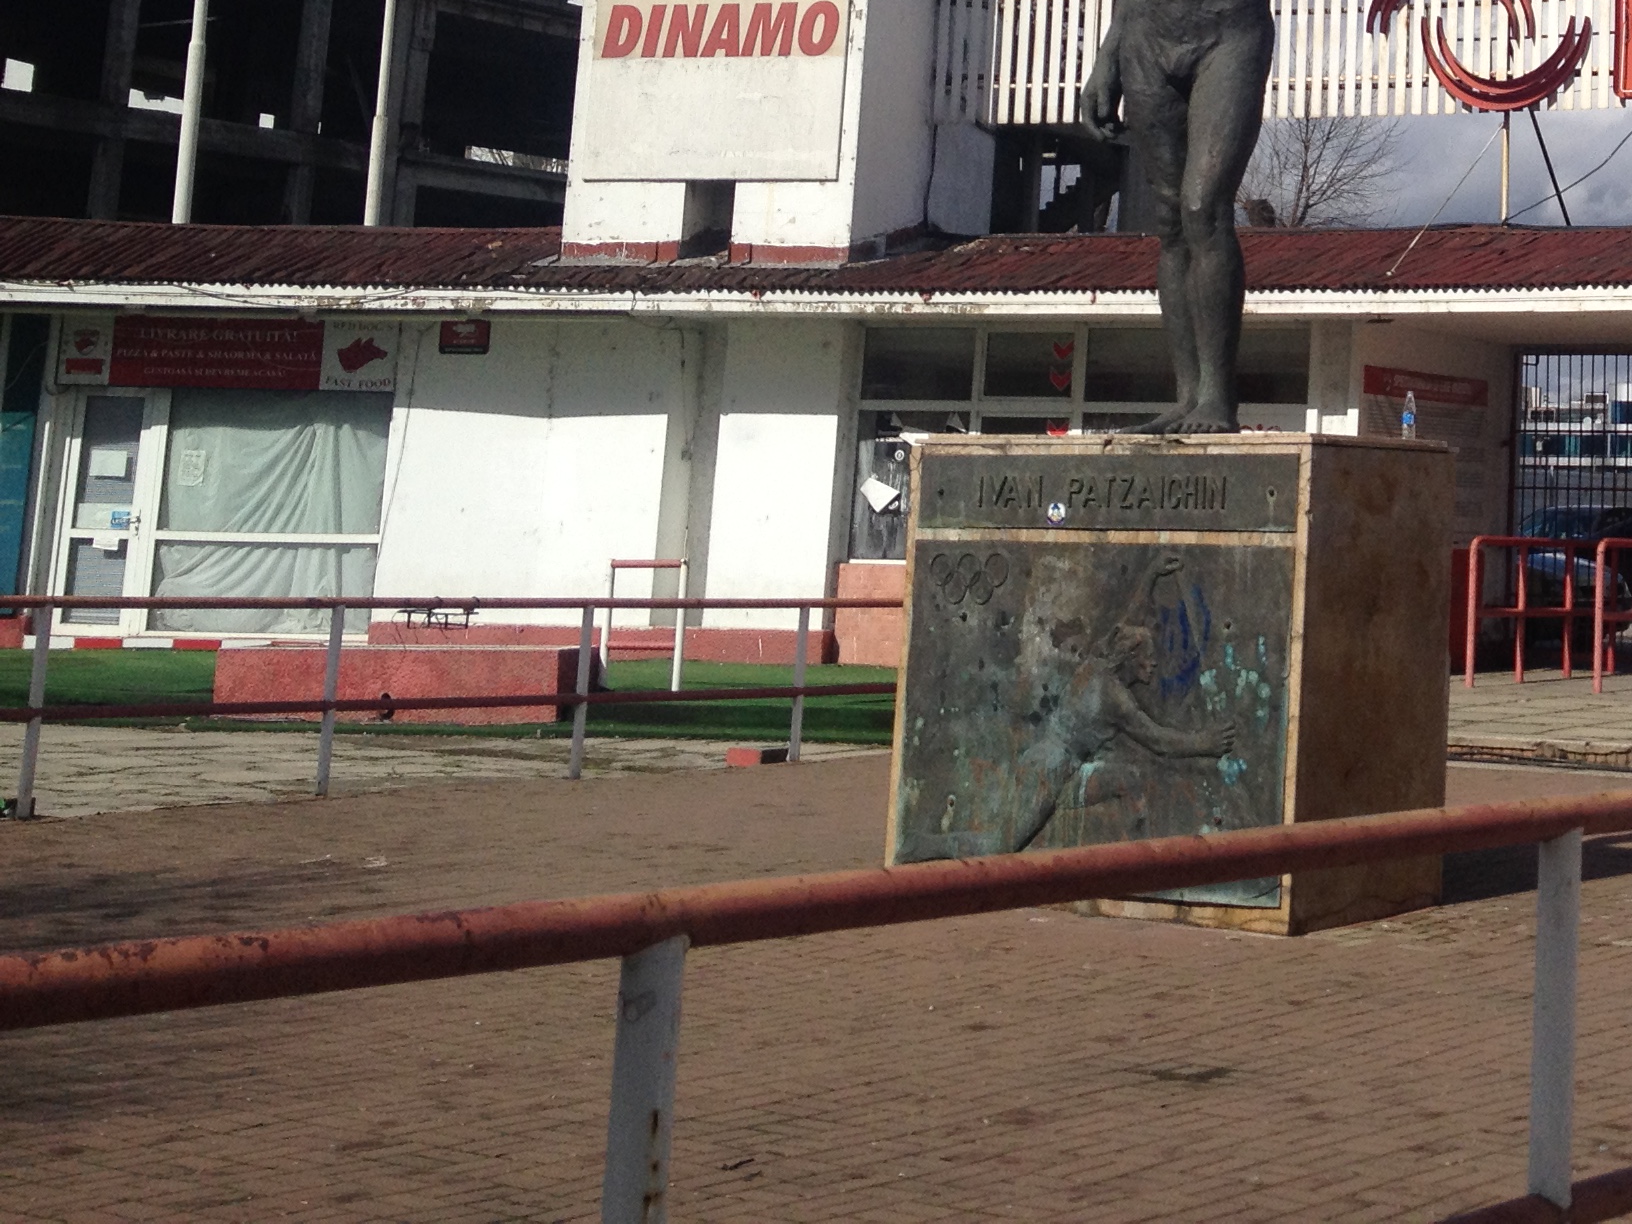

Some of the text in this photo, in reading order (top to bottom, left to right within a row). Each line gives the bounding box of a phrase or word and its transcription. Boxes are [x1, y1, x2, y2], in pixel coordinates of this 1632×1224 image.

[601, 0, 840, 59] DINAMO
[139, 327, 209, 341] LIVRARE
[358, 377, 392, 389] FOOD
[978, 475, 1228, 511] IVAN PATZAICHIN
